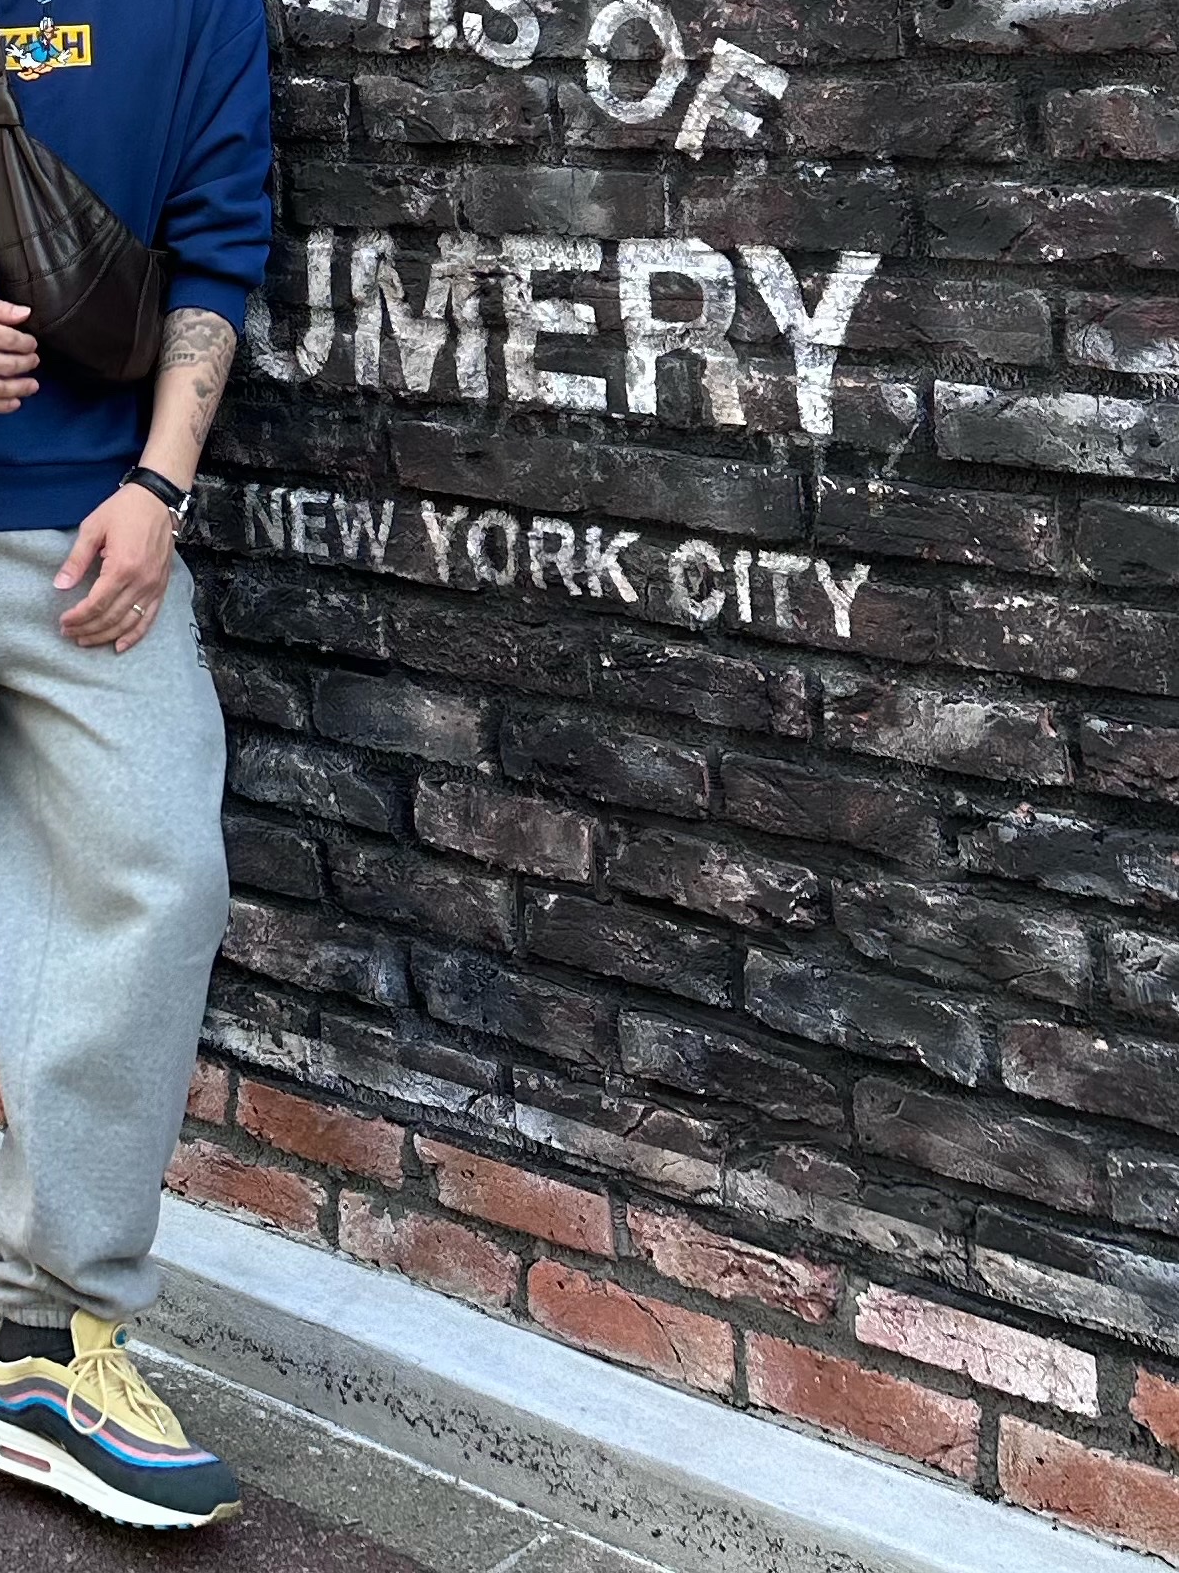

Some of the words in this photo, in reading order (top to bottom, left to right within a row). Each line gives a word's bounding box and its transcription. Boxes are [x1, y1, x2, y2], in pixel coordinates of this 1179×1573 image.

[243, 483, 394, 567] NEW
[421, 499, 641, 602] YORK
[668, 538, 871, 639] CITY
